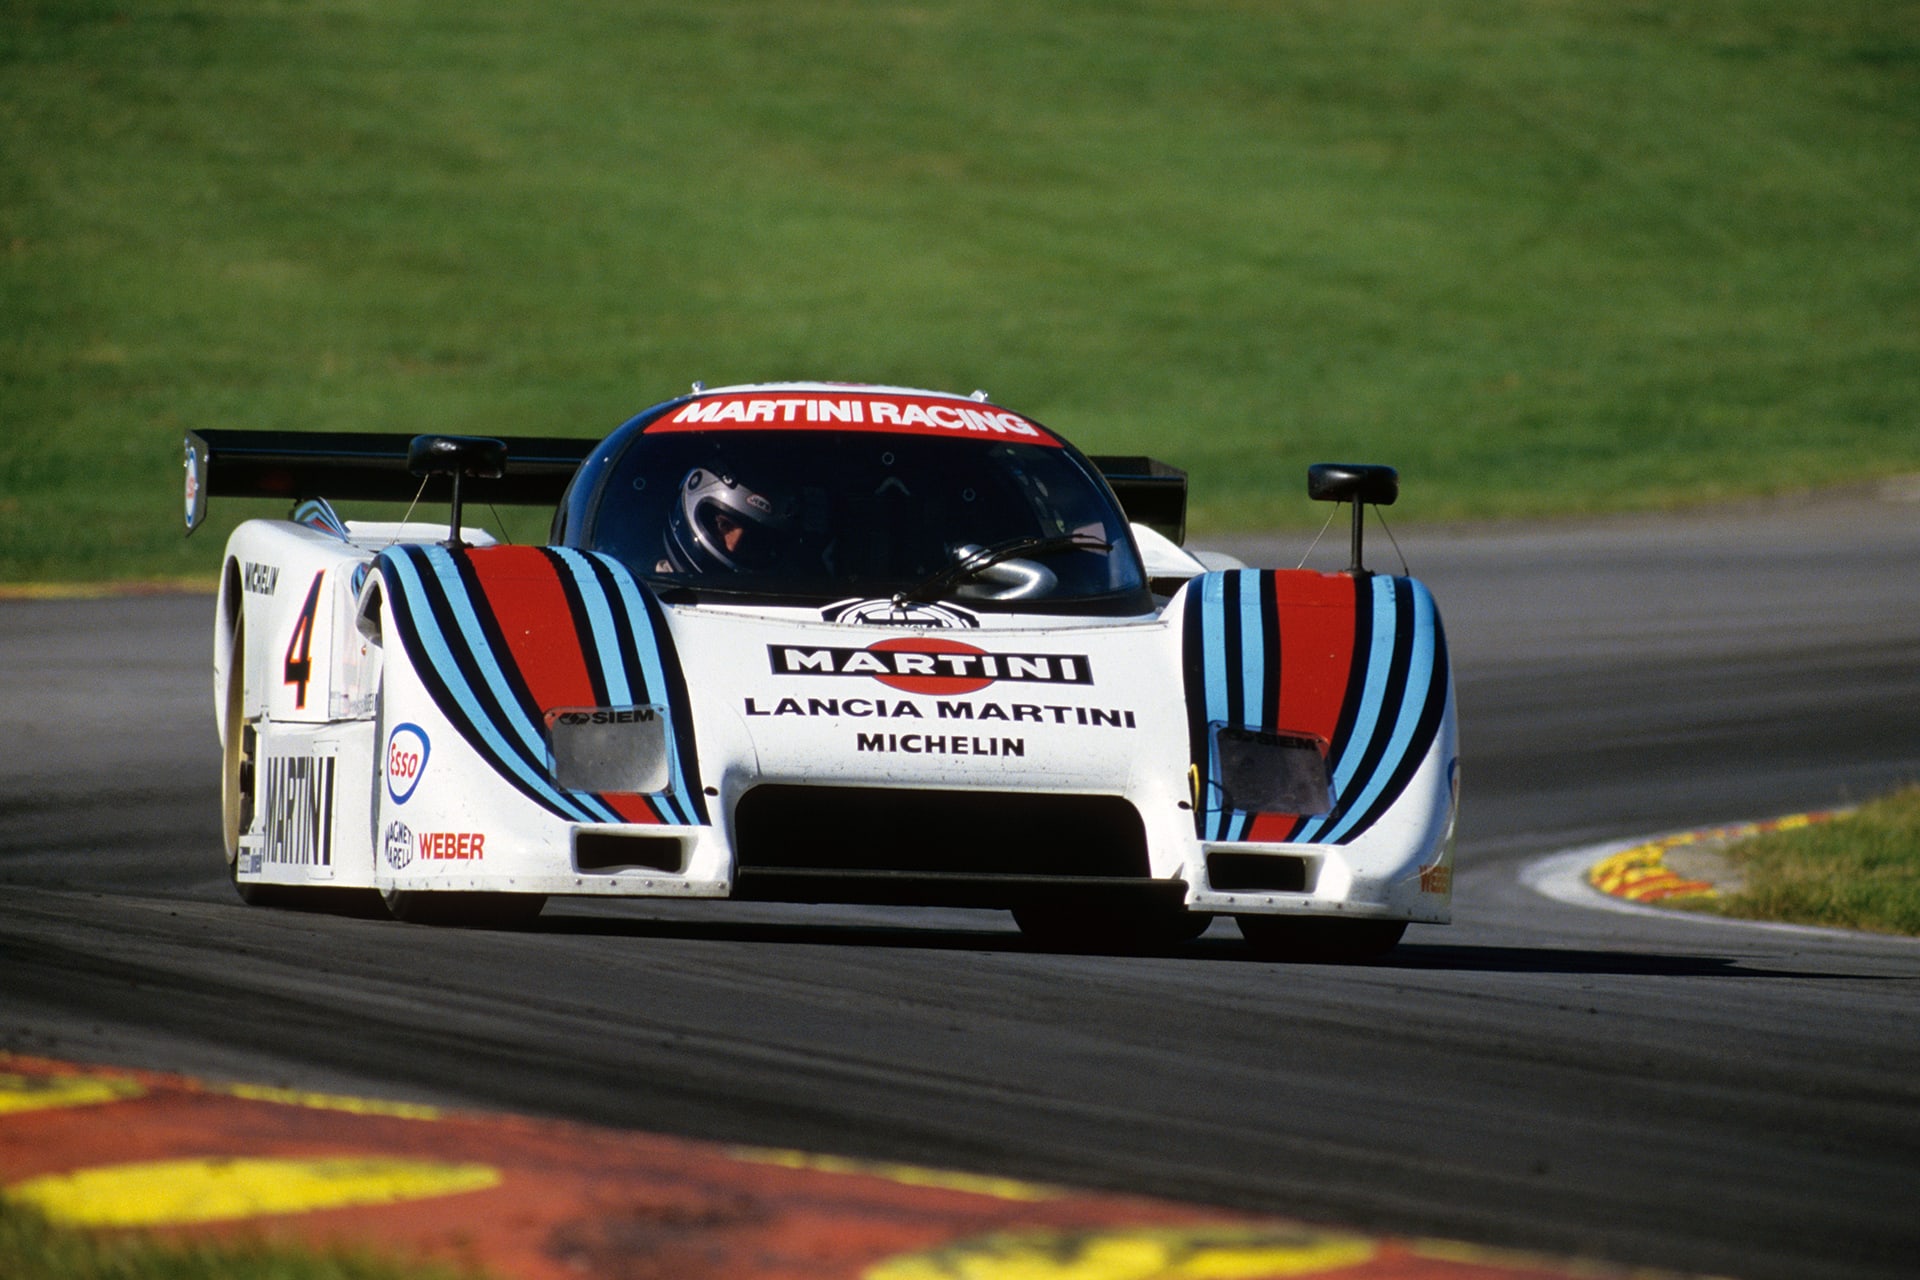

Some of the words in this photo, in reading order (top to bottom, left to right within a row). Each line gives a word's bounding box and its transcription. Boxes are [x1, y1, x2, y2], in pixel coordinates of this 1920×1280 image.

[672, 398, 865, 424] MARTINI
[869, 401, 1040, 437] RACING
[245, 561, 280, 597] MICHELIN
[283, 567, 327, 710] 4
[783, 648, 1078, 681] MARTINI
[591, 709, 655, 725] SIEM
[743, 696, 924, 719] LANCIA
[935, 700, 1137, 729] MARTINI
[856, 732, 1025, 758] MICHELIN
[262, 755, 336, 866] MARTINI
[418, 832, 486, 861] WEBER
